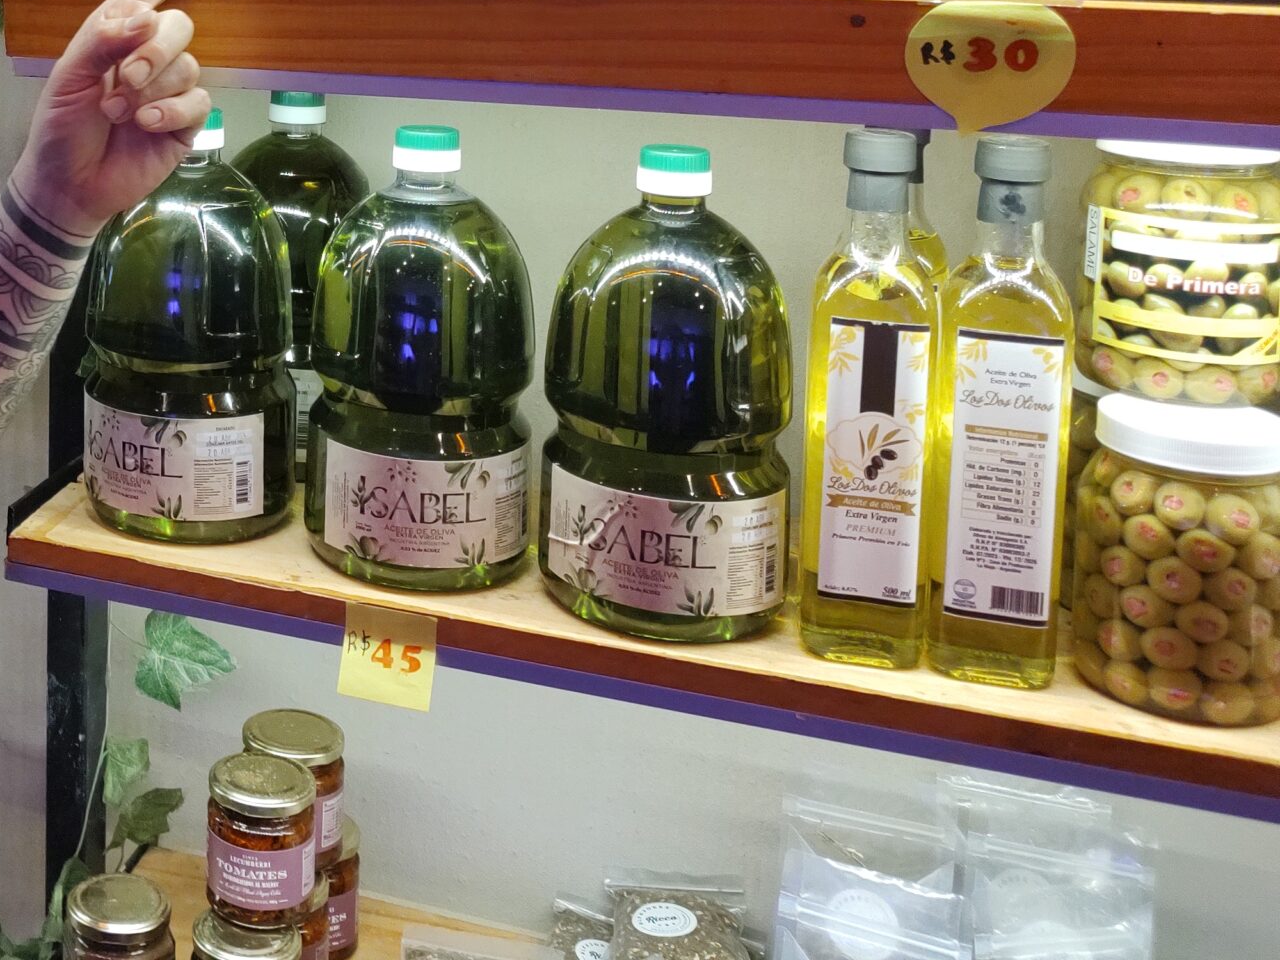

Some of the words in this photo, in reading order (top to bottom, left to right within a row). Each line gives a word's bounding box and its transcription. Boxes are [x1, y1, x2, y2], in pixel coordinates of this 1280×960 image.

[920, 40, 956, 66] R$
[963, 37, 1039, 72] 30
[1127, 266, 1157, 287] De
[1166, 275, 1260, 295] Primera
[960, 389, 984, 407] Los
[984, 391, 1010, 407] Dos
[1014, 394, 1054, 412] Olivos
[827, 476, 850, 493] Los
[851, 477, 877, 492] Dos
[879, 481, 916, 497] Olivos
[845, 510, 868, 520] Extra
[871, 512, 898, 523] Virgen
[384, 524, 414, 534] ACEITE
[431, 528, 455, 536] OLIVA
[846, 524, 896, 536] PREMIUM
[348, 629, 371, 656] R$
[371, 638, 423, 673] 45
[216, 857, 287, 880] TOMATES
